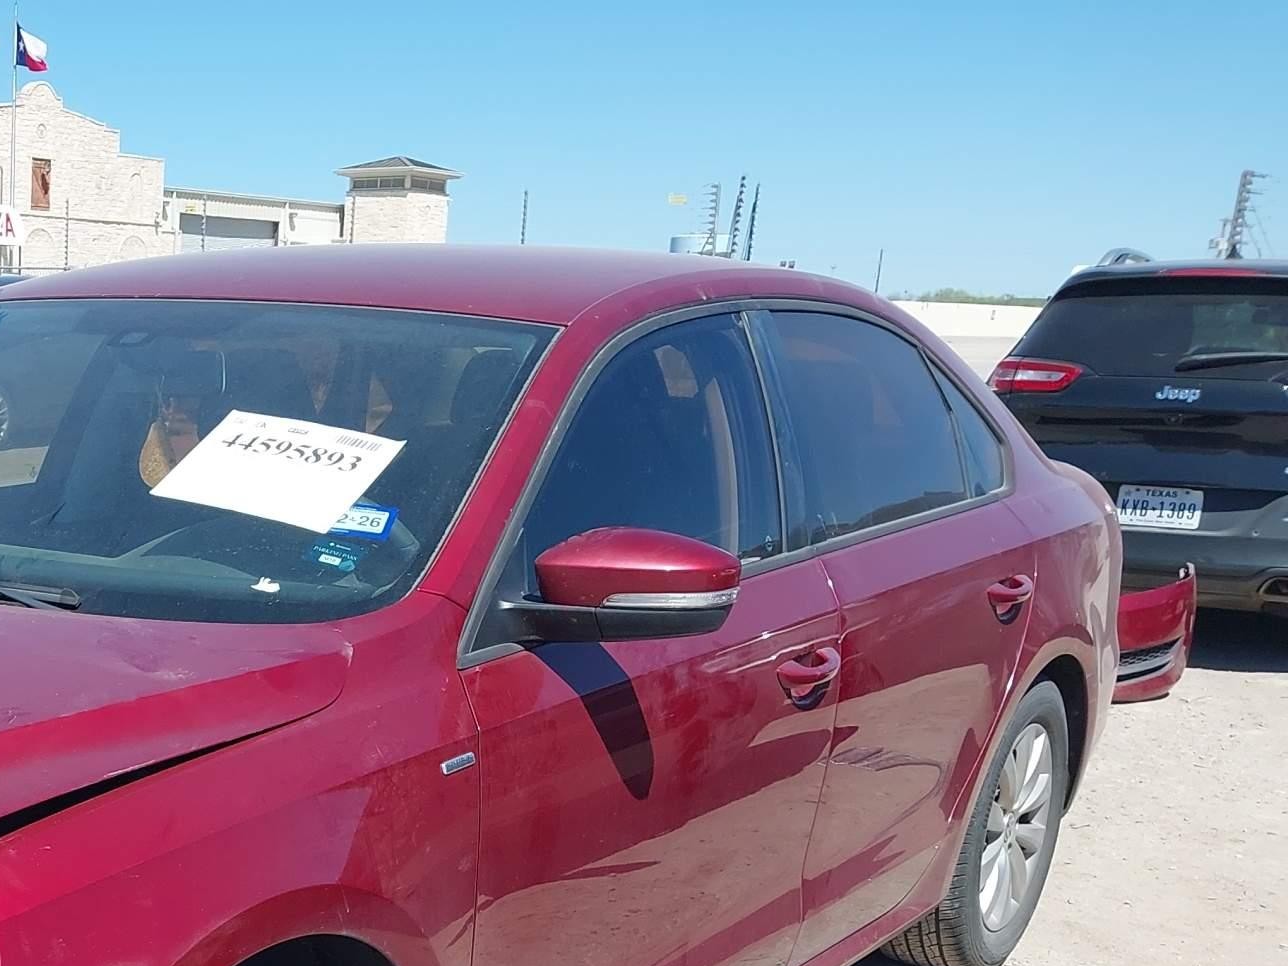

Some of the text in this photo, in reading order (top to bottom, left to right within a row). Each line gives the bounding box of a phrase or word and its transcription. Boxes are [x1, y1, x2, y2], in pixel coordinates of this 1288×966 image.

[1157, 386, 1201, 402] Jeep
[222, 433, 362, 471] 44595893
[1145, 489, 1178, 498] TEXAS
